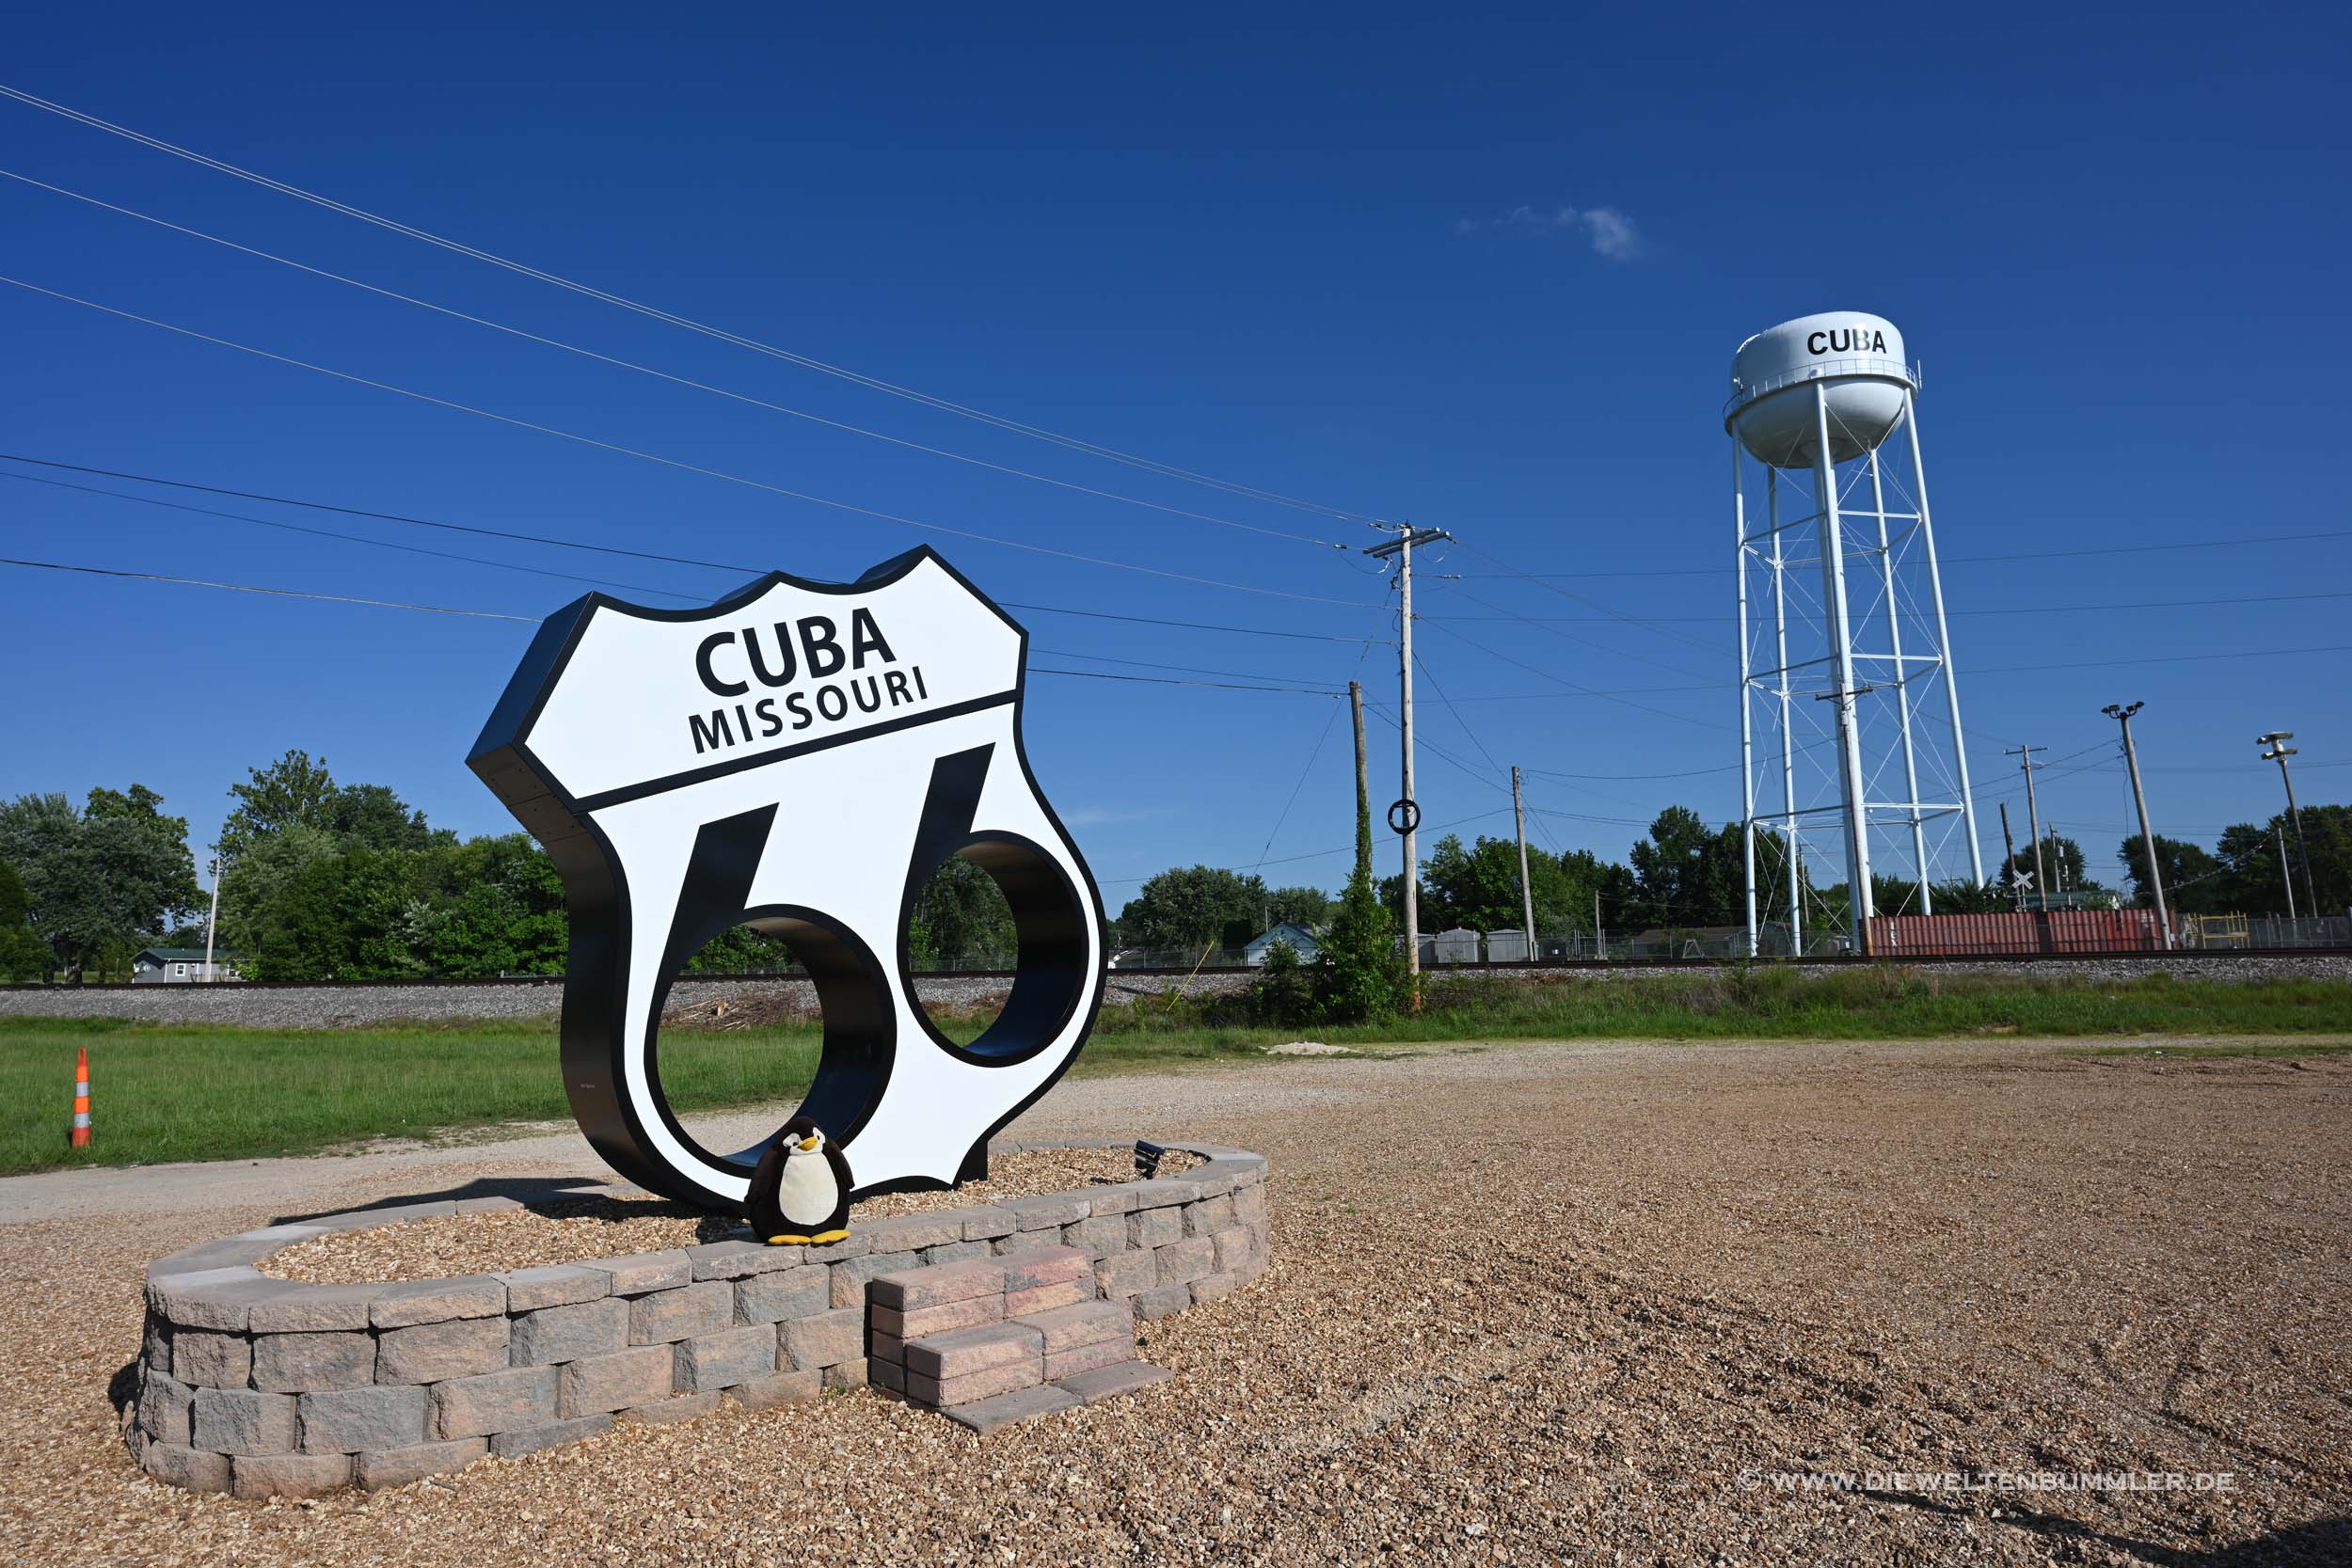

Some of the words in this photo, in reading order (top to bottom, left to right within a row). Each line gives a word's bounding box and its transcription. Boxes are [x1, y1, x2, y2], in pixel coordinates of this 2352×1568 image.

[1807, 328, 1887, 355] CUBA
[695, 607, 898, 698] CUBA
[689, 666, 928, 754] MISSOURI
[644, 741, 1089, 1178] 66
